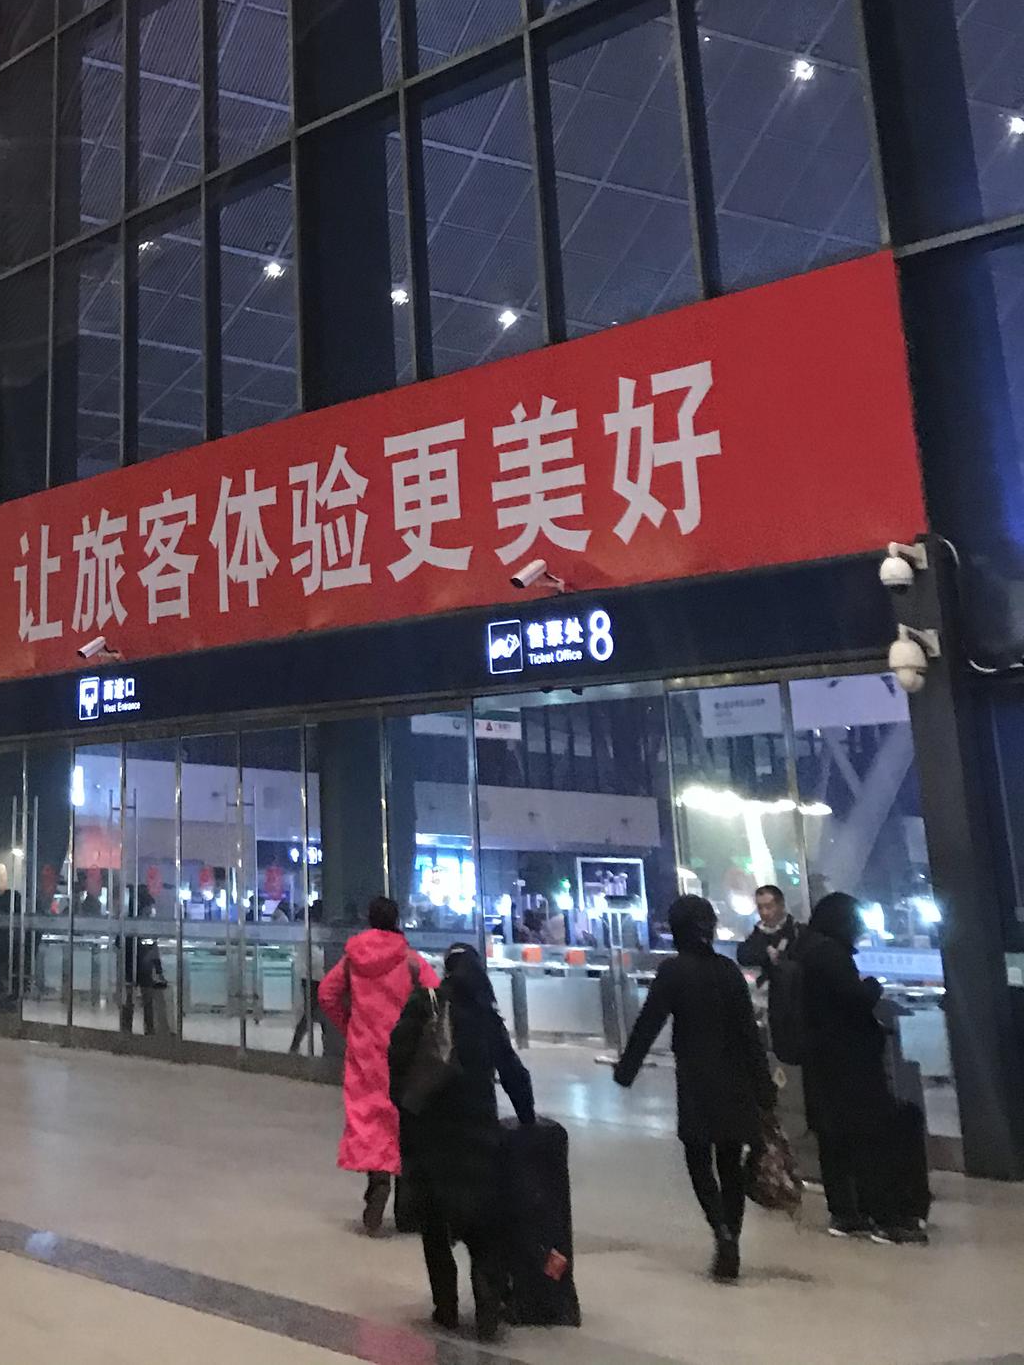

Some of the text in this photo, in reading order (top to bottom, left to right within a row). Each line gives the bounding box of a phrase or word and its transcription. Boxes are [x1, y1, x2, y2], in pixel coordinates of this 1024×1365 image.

[12, 360, 723, 644] 让旅客体验更美好
[528, 649, 583, 665] Ticket Office
[589, 610, 614, 661] 8
